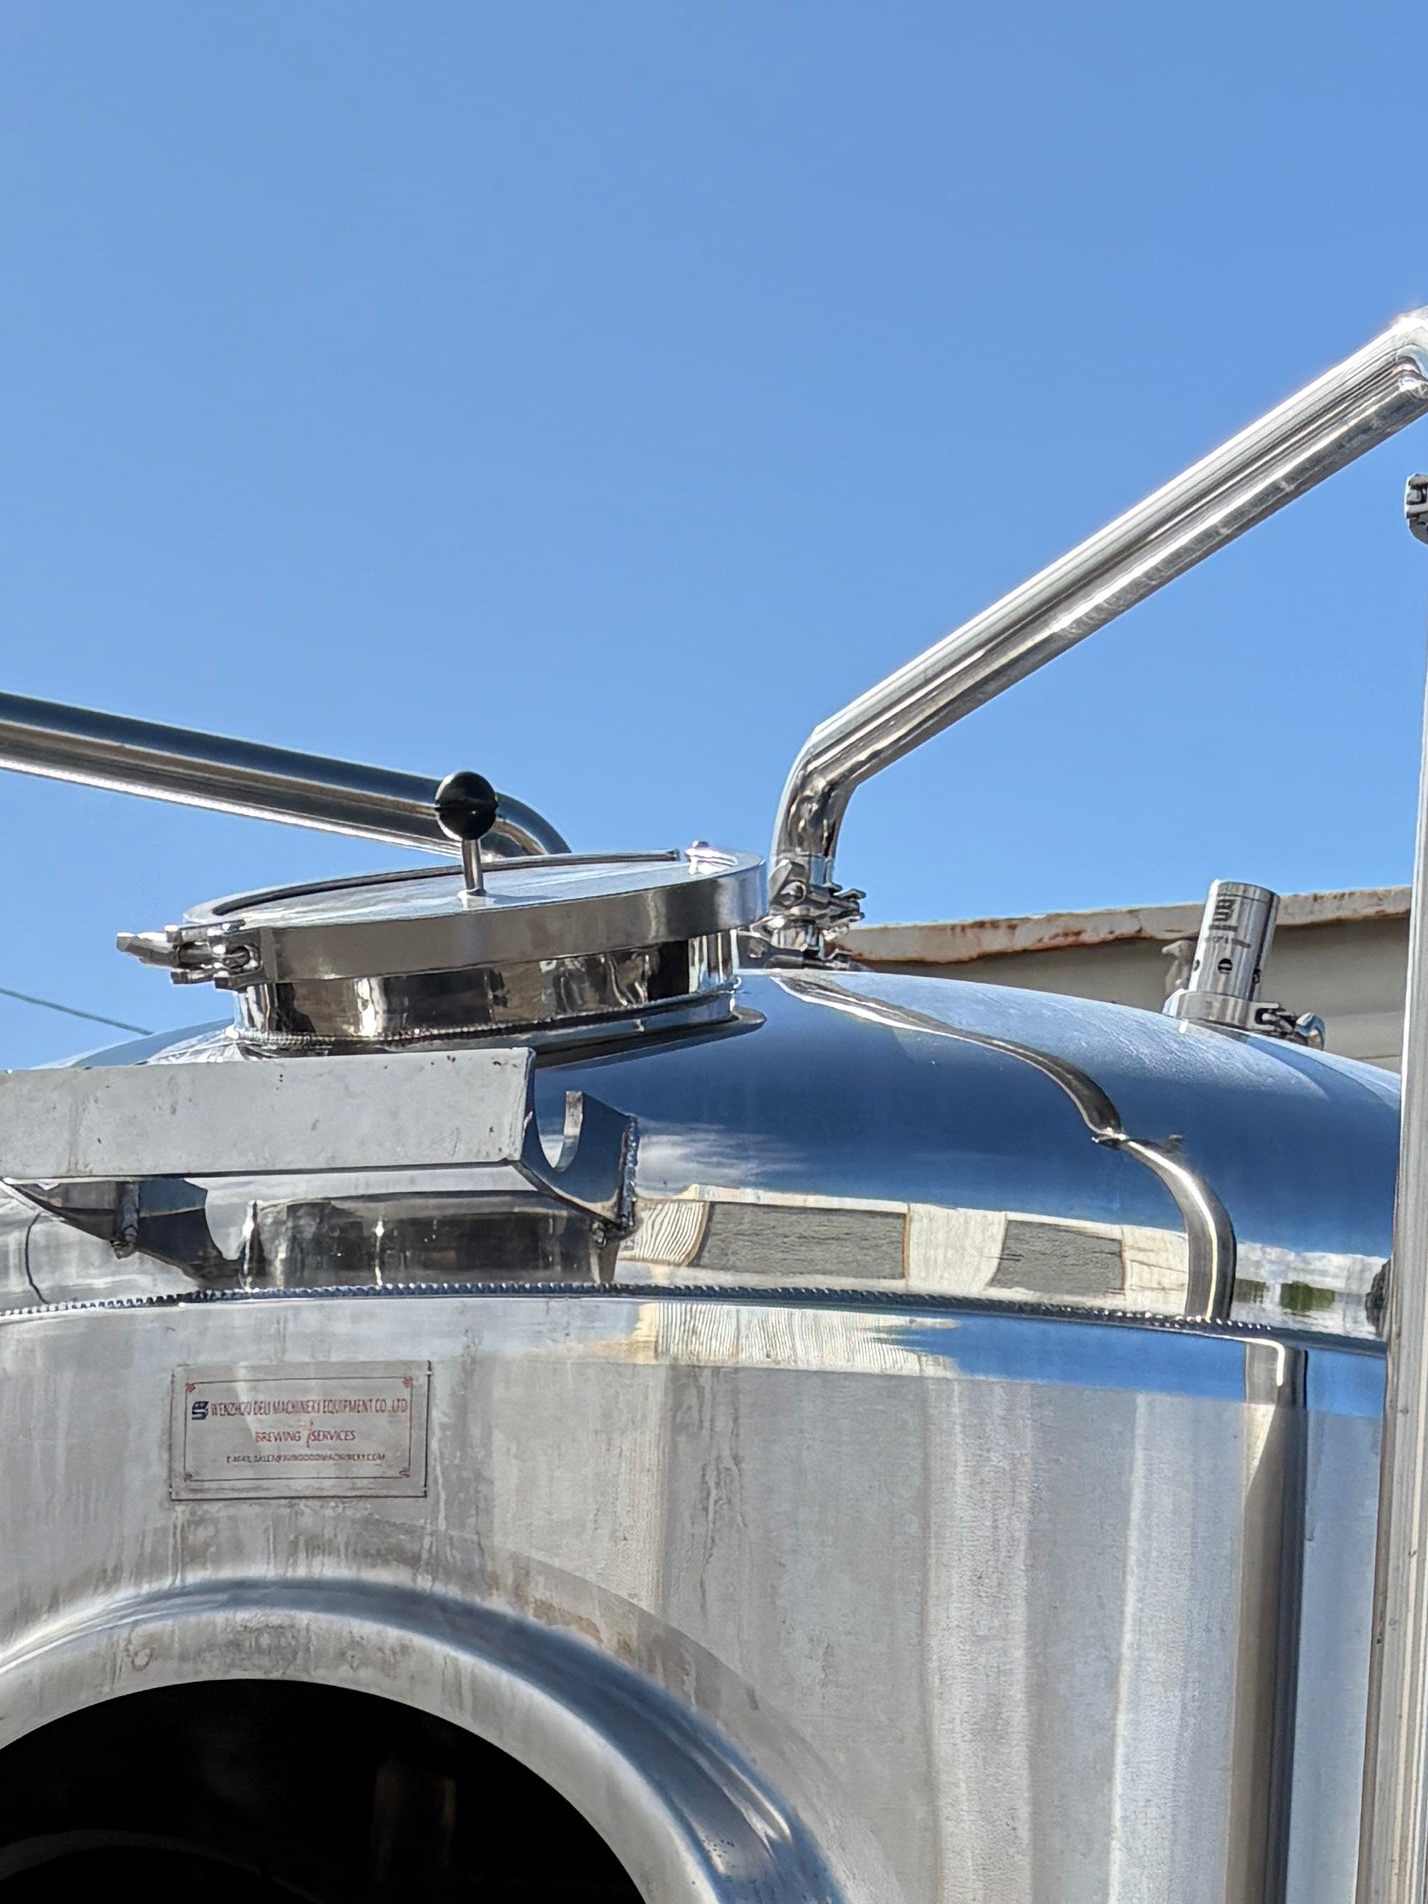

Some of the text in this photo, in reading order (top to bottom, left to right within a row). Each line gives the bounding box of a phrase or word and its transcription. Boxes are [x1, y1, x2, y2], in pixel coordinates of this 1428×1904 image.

[322, 1399, 373, 1414] EQUIPMENT
[255, 1430, 356, 1442] BREWING SERVICES
